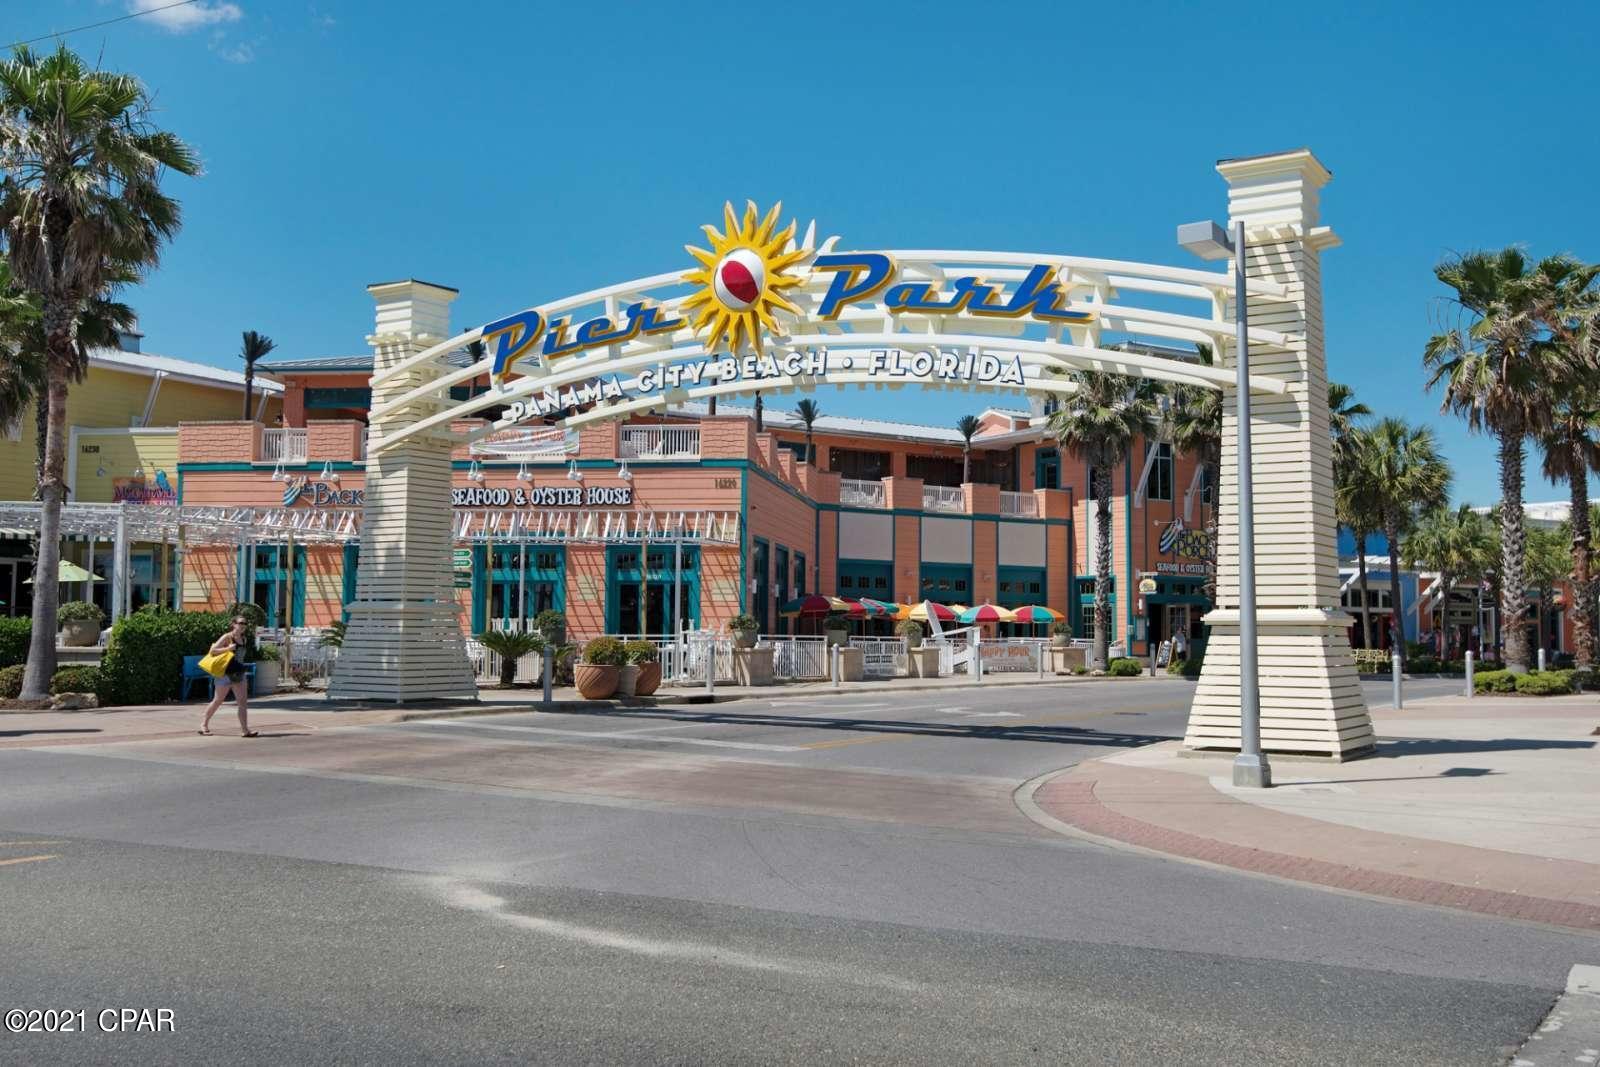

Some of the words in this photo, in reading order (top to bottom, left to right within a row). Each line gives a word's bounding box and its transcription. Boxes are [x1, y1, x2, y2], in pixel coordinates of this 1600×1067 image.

[480, 304, 688, 382] Pier
[811, 252, 1096, 325] Park
[508, 374, 625, 423] PANAMA
[636, 361, 706, 393] CITY
[720, 350, 828, 382] BEACH
[868, 350, 1025, 385] FLORIDA
[451, 487, 511, 506] SEAFOOD
[513, 488, 527, 505] &
[530, 487, 583, 506] OYSTER
[585, 487, 632, 506] HOUSE
